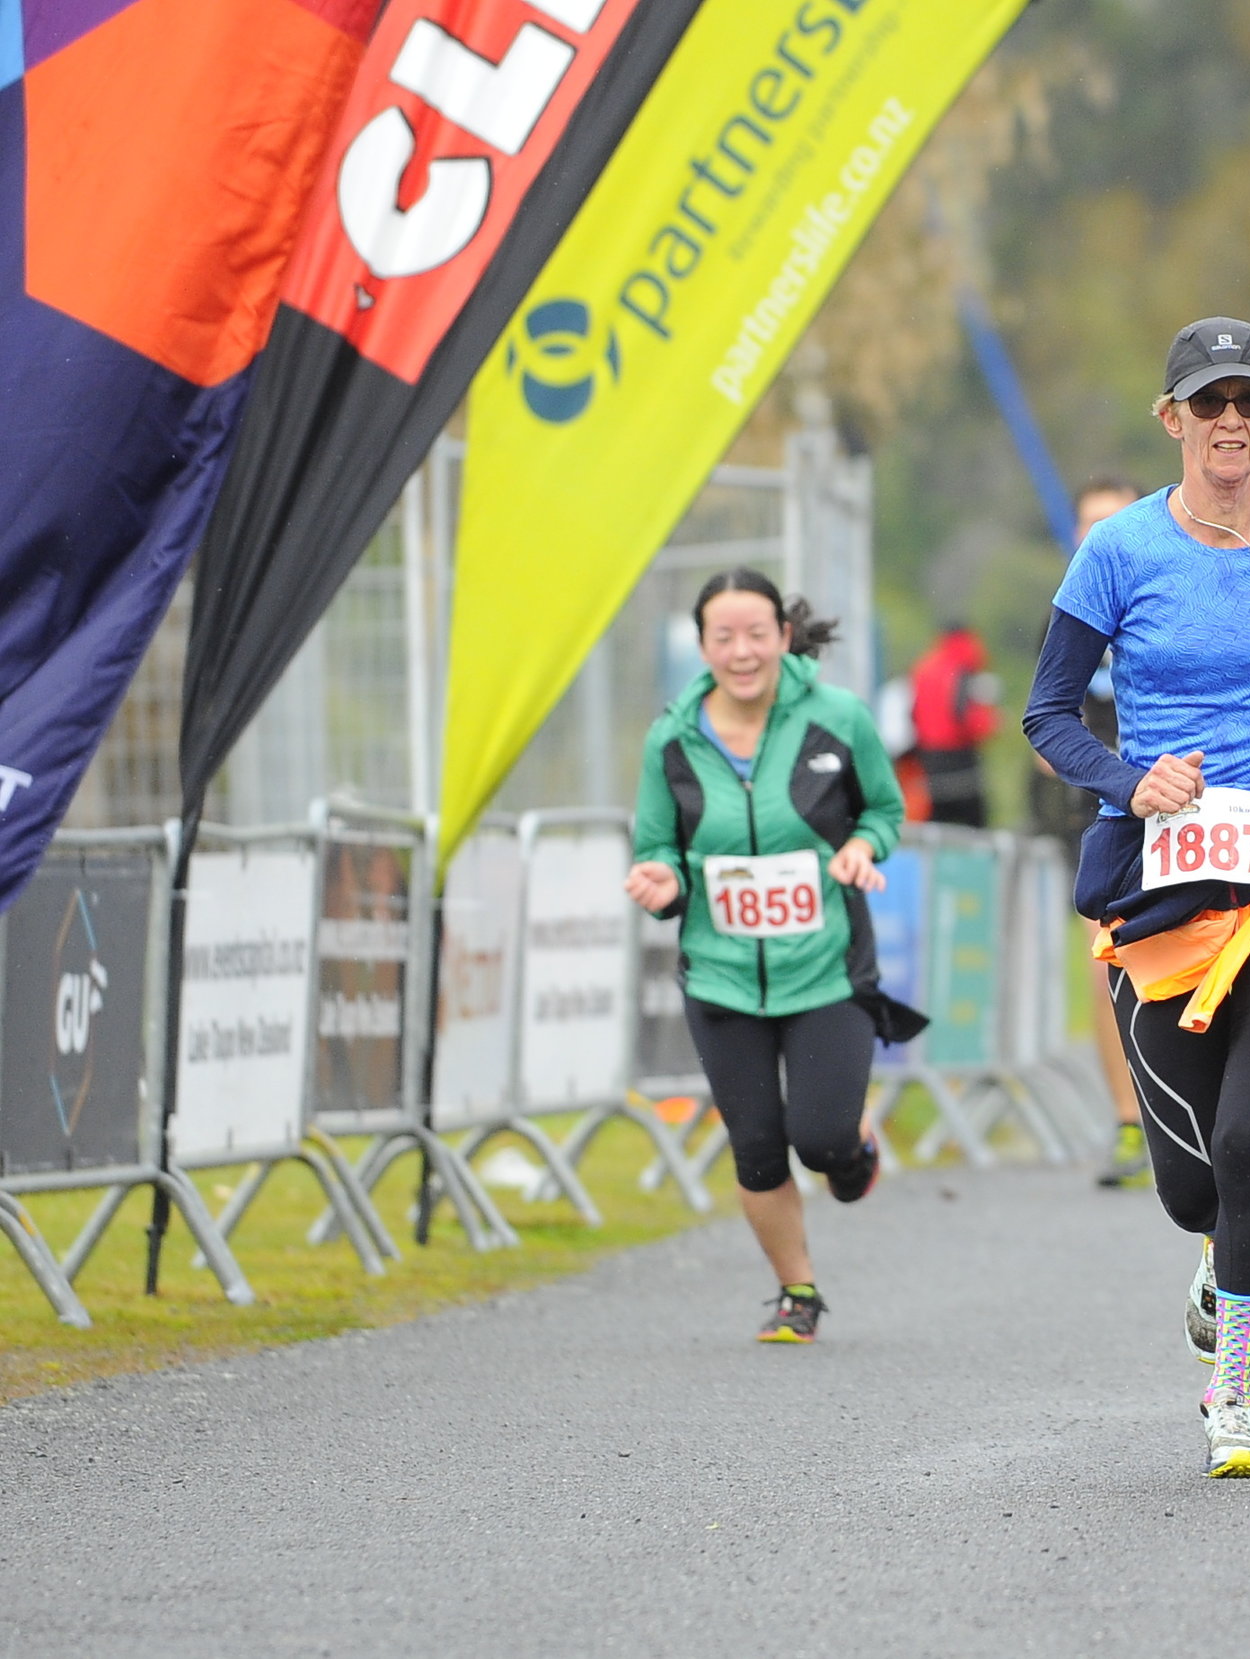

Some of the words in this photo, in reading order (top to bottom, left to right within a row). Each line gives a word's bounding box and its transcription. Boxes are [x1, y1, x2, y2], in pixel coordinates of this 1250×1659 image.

[711, 96, 916, 404] partnerslife.co.nz
[715, 884, 816, 928] 1859
[55, 971, 91, 1054] GU
